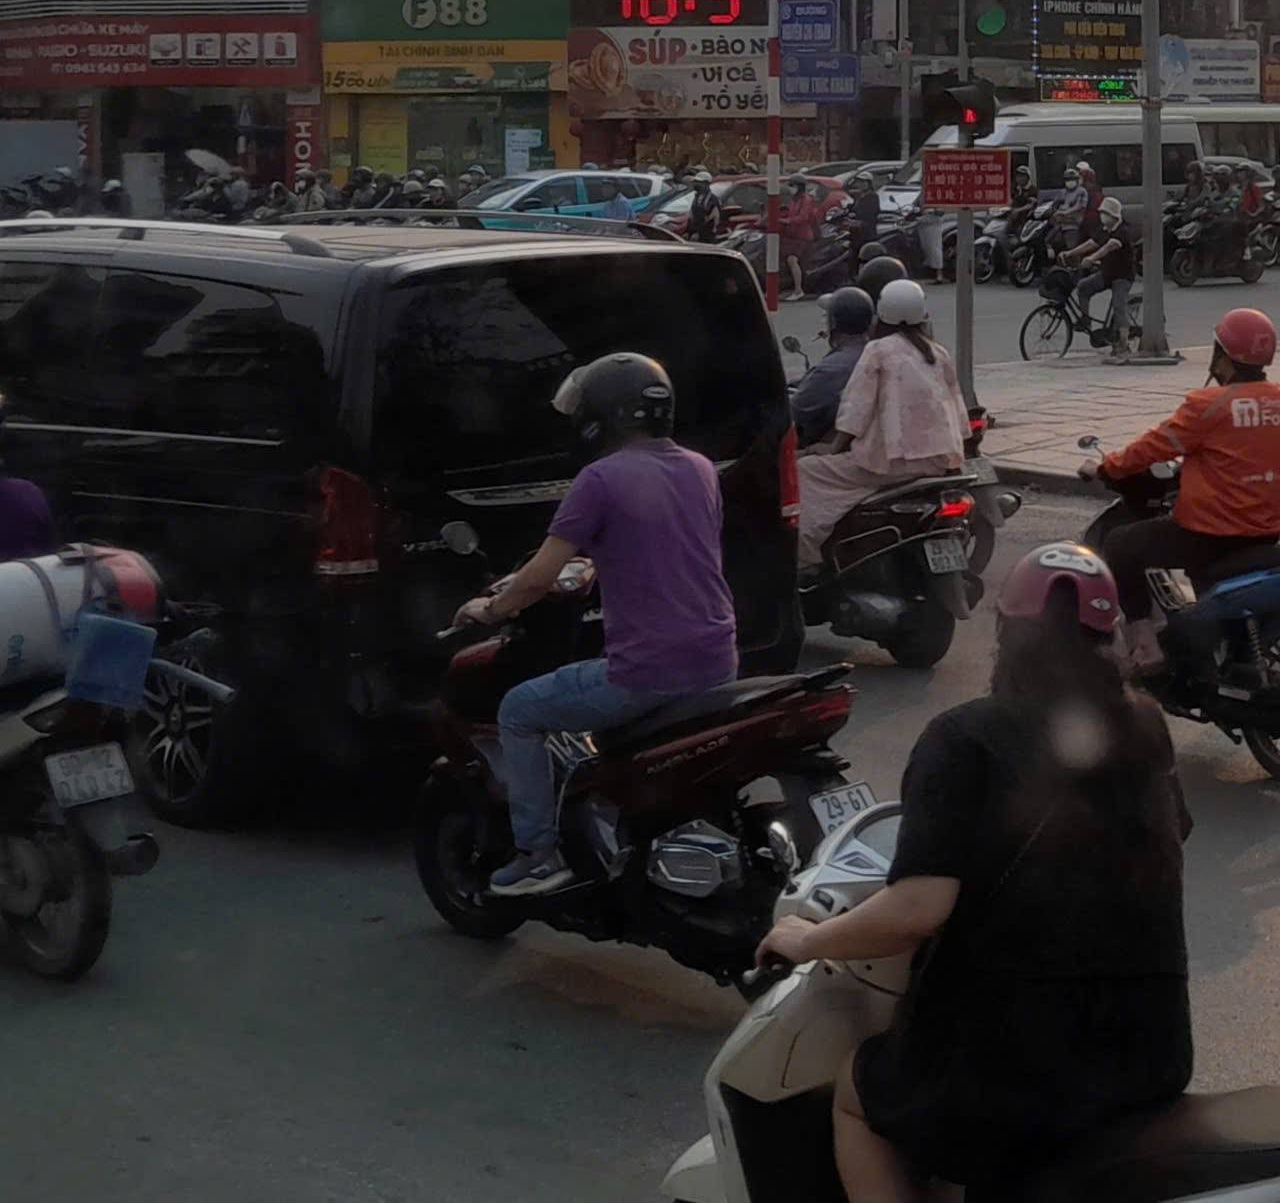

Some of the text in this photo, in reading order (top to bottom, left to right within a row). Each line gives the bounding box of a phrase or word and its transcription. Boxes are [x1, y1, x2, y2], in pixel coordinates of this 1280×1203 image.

[99, 24, 118, 35] XE
[88, 44, 147, 57] SUZUKI
[629, 30, 687, 65] SÚP
[750, 38, 769, 54] N
[734, 85, 768, 110] YẾ
[821, 789, 868, 819] 29-G1
